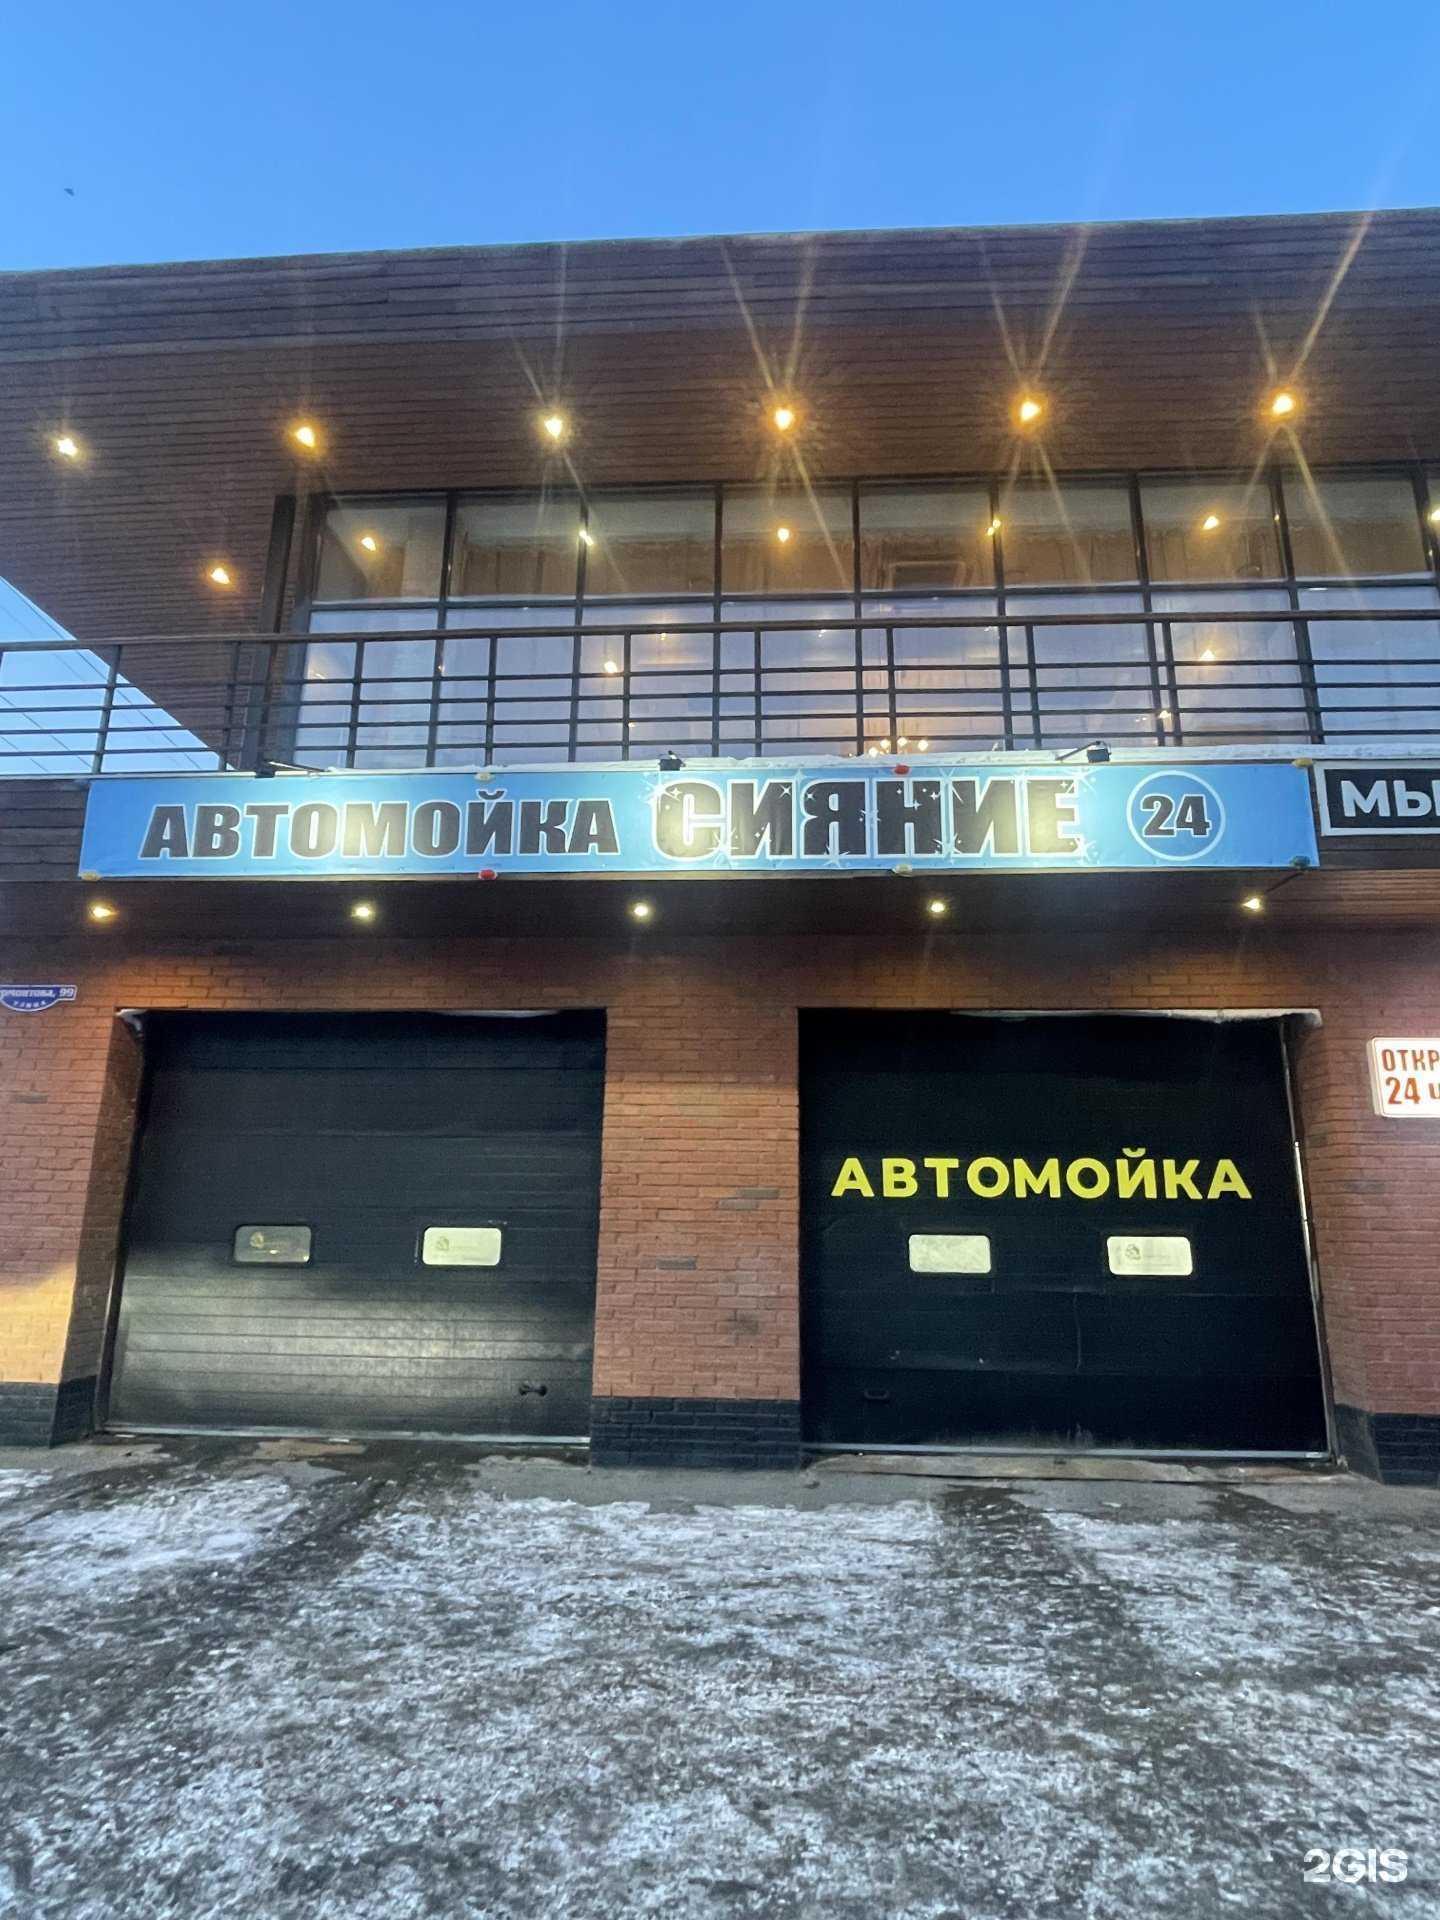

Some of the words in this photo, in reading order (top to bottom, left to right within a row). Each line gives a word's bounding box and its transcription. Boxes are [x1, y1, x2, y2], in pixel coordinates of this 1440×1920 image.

[138, 790, 620, 859] АВТОМОЙКА
[652, 776, 1084, 860] СИЯНИЕ
[1139, 793, 1211, 838] 24
[1385, 1076, 1421, 1105] 24
[830, 1147, 1253, 1199] АВТОМОЙКА
